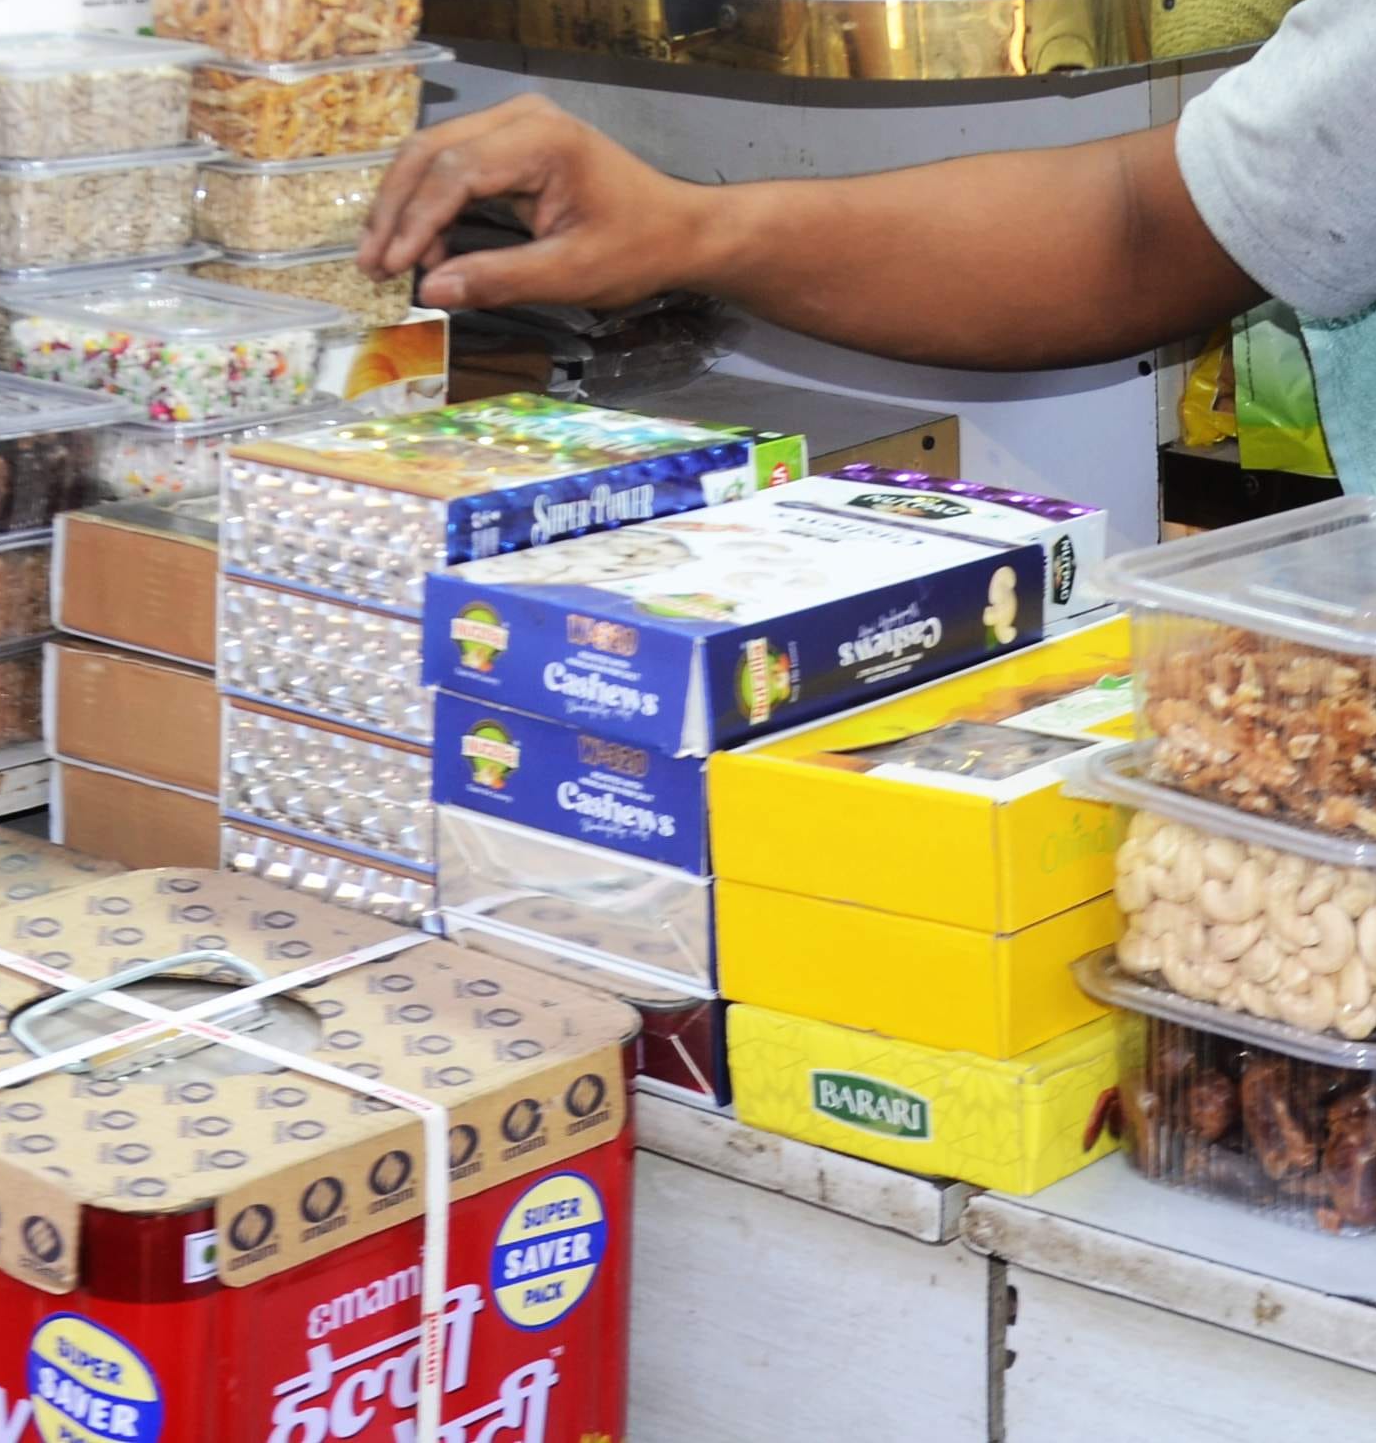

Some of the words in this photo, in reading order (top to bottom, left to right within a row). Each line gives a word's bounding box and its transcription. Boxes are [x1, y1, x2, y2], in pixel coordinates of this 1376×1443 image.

[818, 1077, 922, 1133] BARARI
[521, 1197, 583, 1232] SUPER
[503, 1232, 592, 1281] SAVER
[307, 1260, 424, 1341] emam
[521, 1280, 567, 1310] PACK
[55, 1336, 124, 1386] SUPER
[38, 1366, 140, 1438] SAVER
